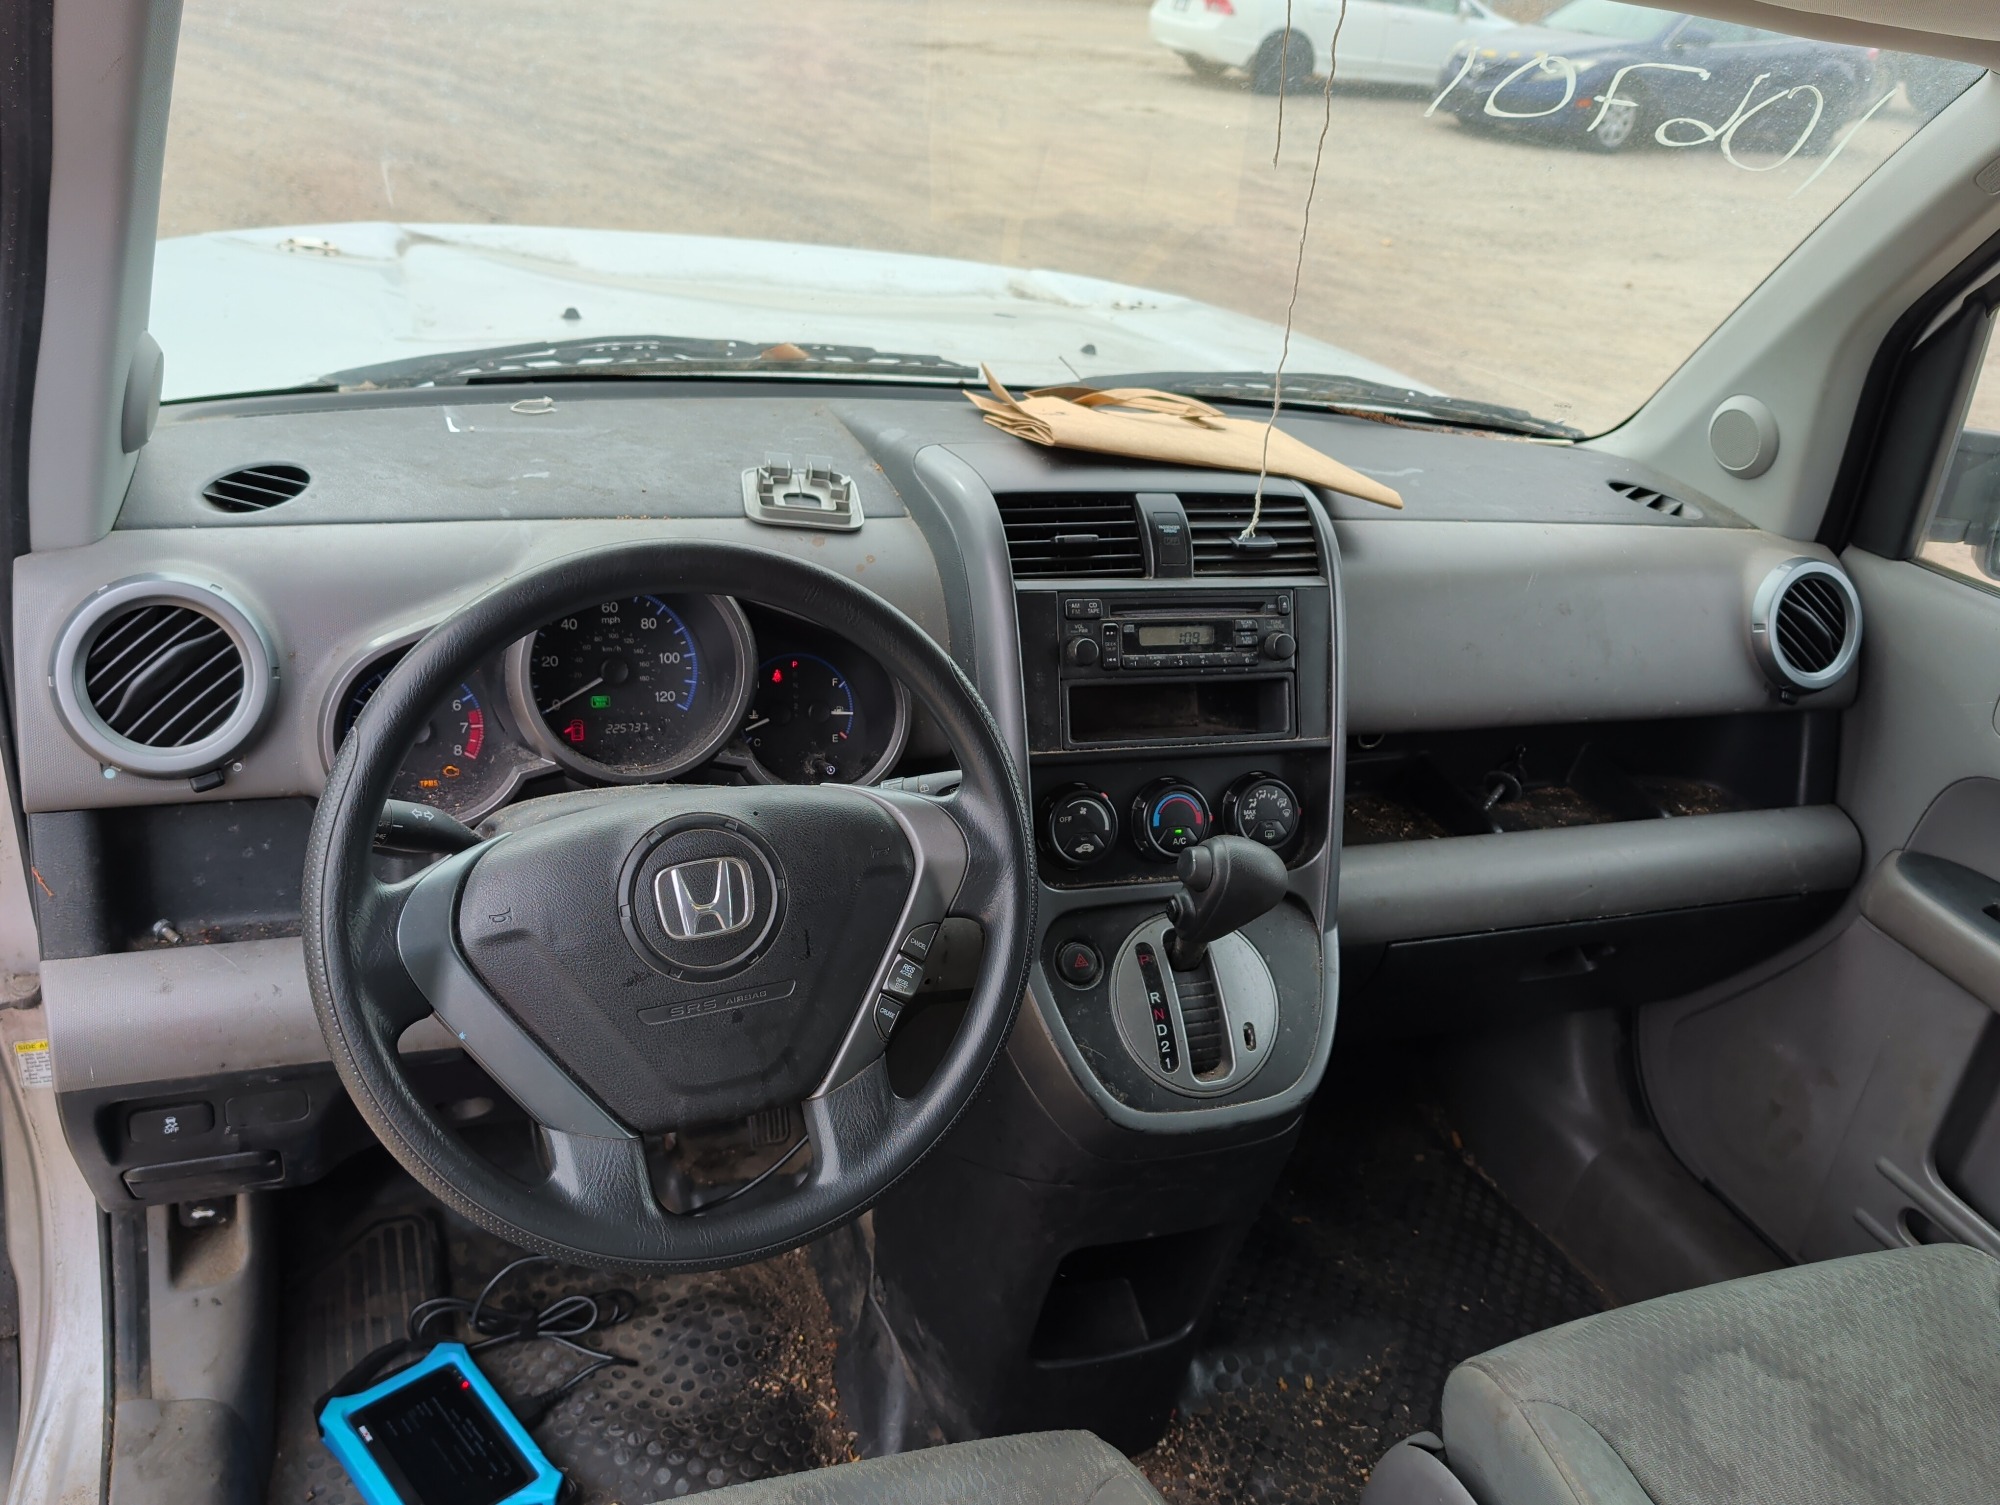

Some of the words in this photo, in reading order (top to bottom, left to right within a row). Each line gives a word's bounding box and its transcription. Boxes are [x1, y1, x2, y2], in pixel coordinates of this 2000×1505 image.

[601, 601, 619, 613] 60
[560, 618, 578, 630] 40
[601, 616, 621, 625] mph
[640, 617, 657, 630] 80
[541, 656, 559, 667] 20
[659, 652, 681, 664] 100
[792, 660, 798, 668] P
[832, 678, 838, 687] F
[654, 691, 676, 702] 120
[452, 700, 462, 711] 6
[552, 700, 561, 710] 0
[459, 722, 468, 734] 7
[753, 738, 761, 747] C
[832, 734, 838, 743] E
[453, 744, 463, 756] 8
[419, 779, 439, 788] TPMS
[1172, 837, 1187, 846] A/C
[910, 937, 927, 951] CANCEL
[1138, 954, 1151, 966] P
[902, 963, 916, 974] RES
[670, 999, 717, 1017] SRS
[725, 990, 767, 1005] AIRBAG
[1150, 992, 1160, 1004] R
[880, 1007, 896, 1019] CRUISE
[1153, 1008, 1165, 1020] N
[1156, 1024, 1168, 1036] D
[1160, 1040, 1171, 1053] 2
[1165, 1058, 1171, 1069] 1
[164, 1126, 179, 1134] OFF
